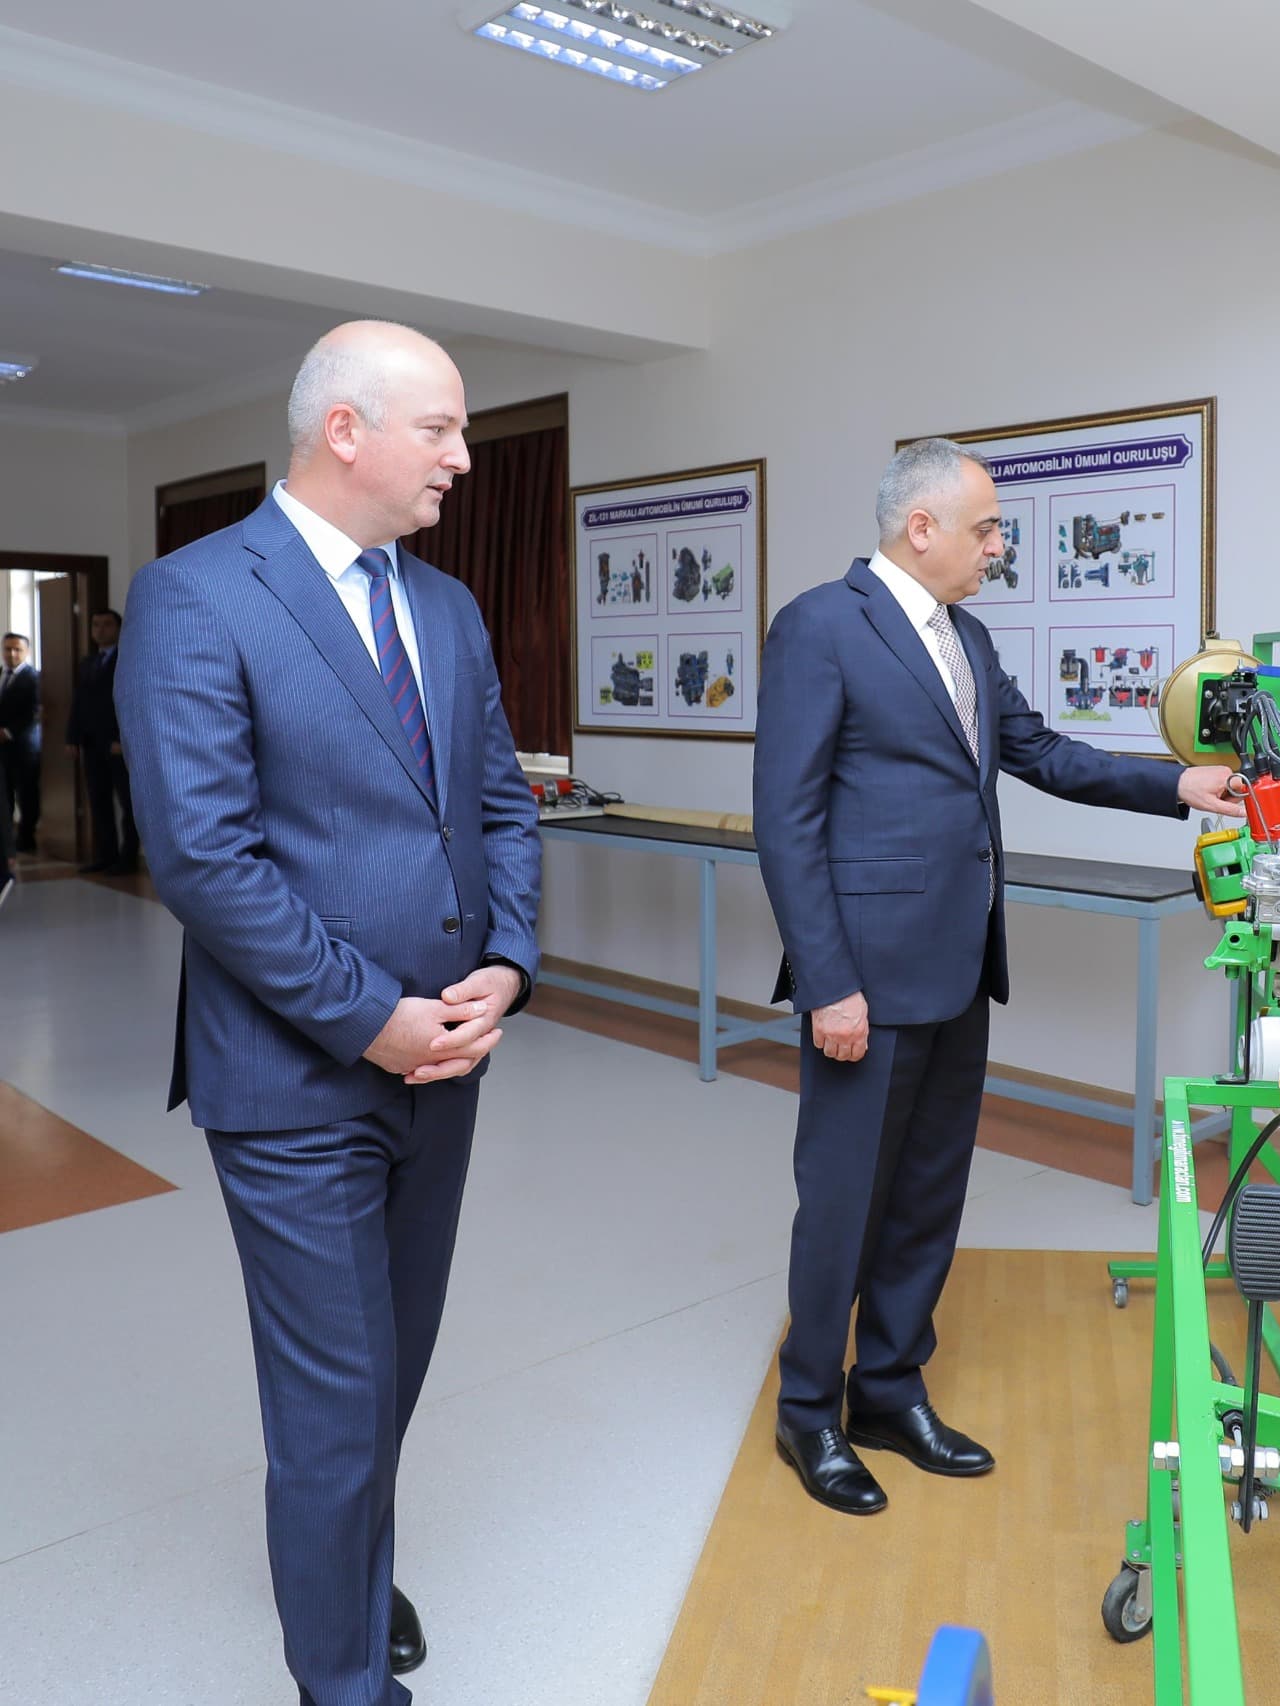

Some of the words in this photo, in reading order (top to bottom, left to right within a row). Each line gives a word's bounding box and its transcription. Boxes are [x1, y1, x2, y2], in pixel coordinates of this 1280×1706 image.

[1002, 455, 1073, 477] AVTOMOBİLİN
[1074, 449, 1111, 469] ÜMUMİ
[1113, 444, 1178, 465] QURULUŞU
